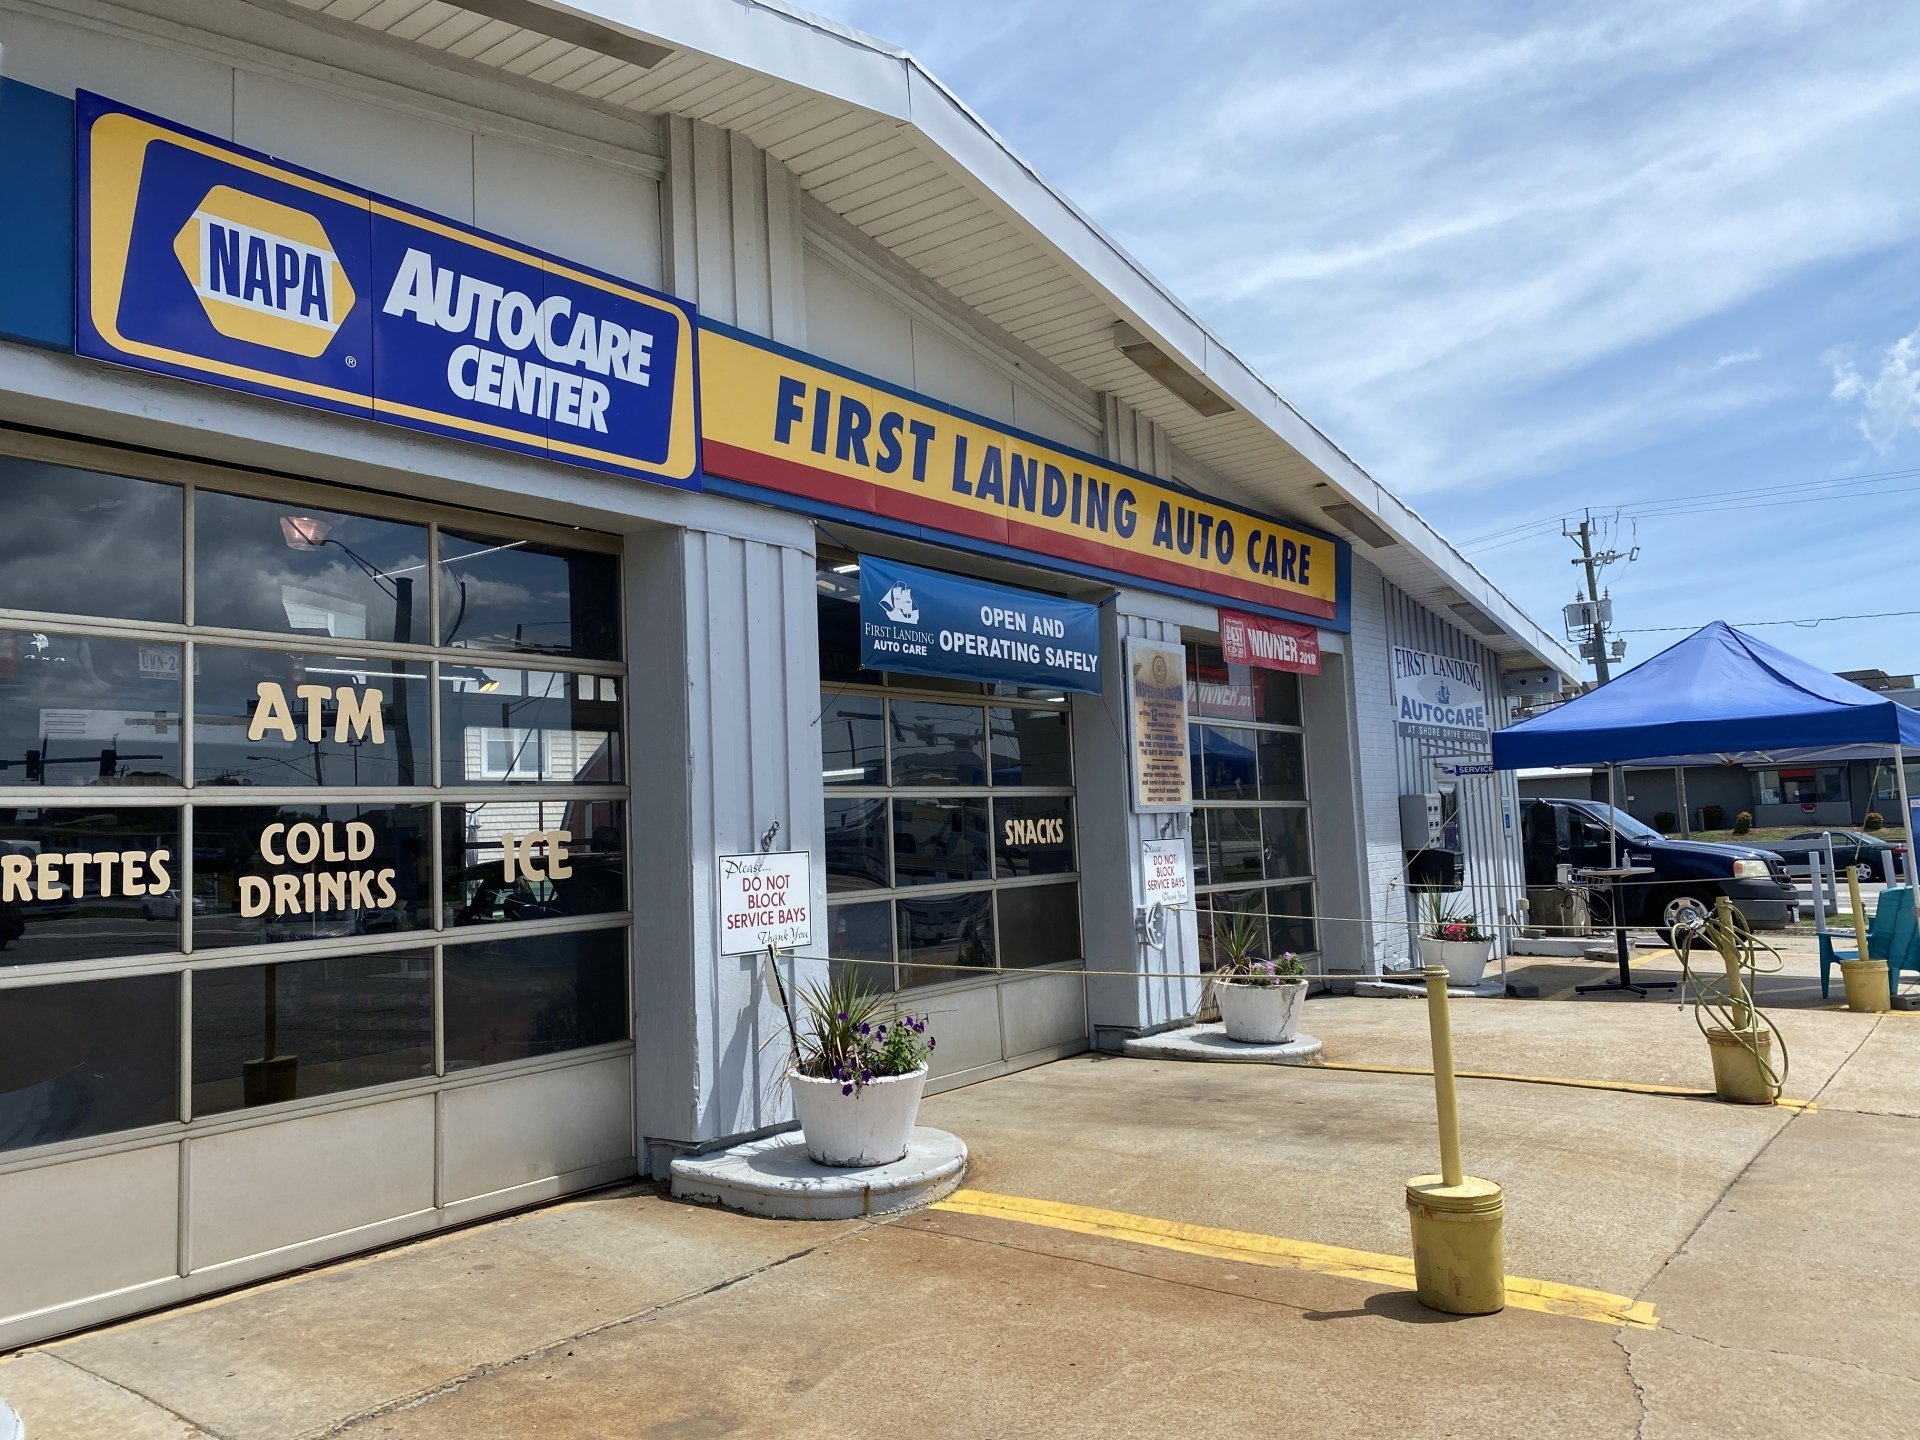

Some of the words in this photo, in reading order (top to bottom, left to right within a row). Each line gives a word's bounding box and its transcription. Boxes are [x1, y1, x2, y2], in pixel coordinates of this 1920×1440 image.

[208, 222, 330, 324] NAPA
[383, 247, 654, 388] AUTOCARE
[447, 343, 611, 434] CENTER
[774, 374, 936, 484] FIRST
[951, 434, 1138, 540] LANDING
[1153, 504, 1235, 566] AUTO
[1247, 528, 1312, 587] CARE
[980, 605, 1027, 633] OPEN
[1032, 615, 1065, 639] AND
[1225, 624, 1243, 643] BEST
[873, 639, 900, 653] AUTO
[902, 642, 928, 656] CARE
[939, 629, 1041, 664] OPERATING
[1045, 646, 1098, 673] SAFELY
[1247, 627, 1298, 663] WINNER
[1394, 647, 1427, 679] FIRST
[1430, 655, 1482, 692] LANDING
[247, 681, 386, 745] ATM
[1150, 707, 1158, 722] 12
[1400, 695, 1485, 728] AUTOCARE
[1407, 725, 1416, 735] AT
[1418, 726, 1440, 738] SHORE
[1443, 729, 1461, 739] DRIVE
[1463, 731, 1482, 741] SHELL
[1458, 765, 1494, 774] SERVICE
[259, 822, 376, 865] COLD
[1004, 818, 1064, 846] SNACKS
[501, 829, 574, 884] ICE
[1153, 855, 1163, 866] DO
[1164, 854, 1177, 864] NOT
[1156, 866, 1175, 877] BLOCK
[0, 849, 171, 902] RETTES
[742, 876, 762, 893] DO
[766, 874, 791, 891] NOT
[1147, 878, 1170, 891] SERVICE
[1171, 877, 1186, 889] BAYS
[239, 868, 398, 918] DRINKS
[747, 891, 786, 909] BLOCK
[727, 910, 774, 930] SERVICE
[778, 907, 806, 924] BAYS
